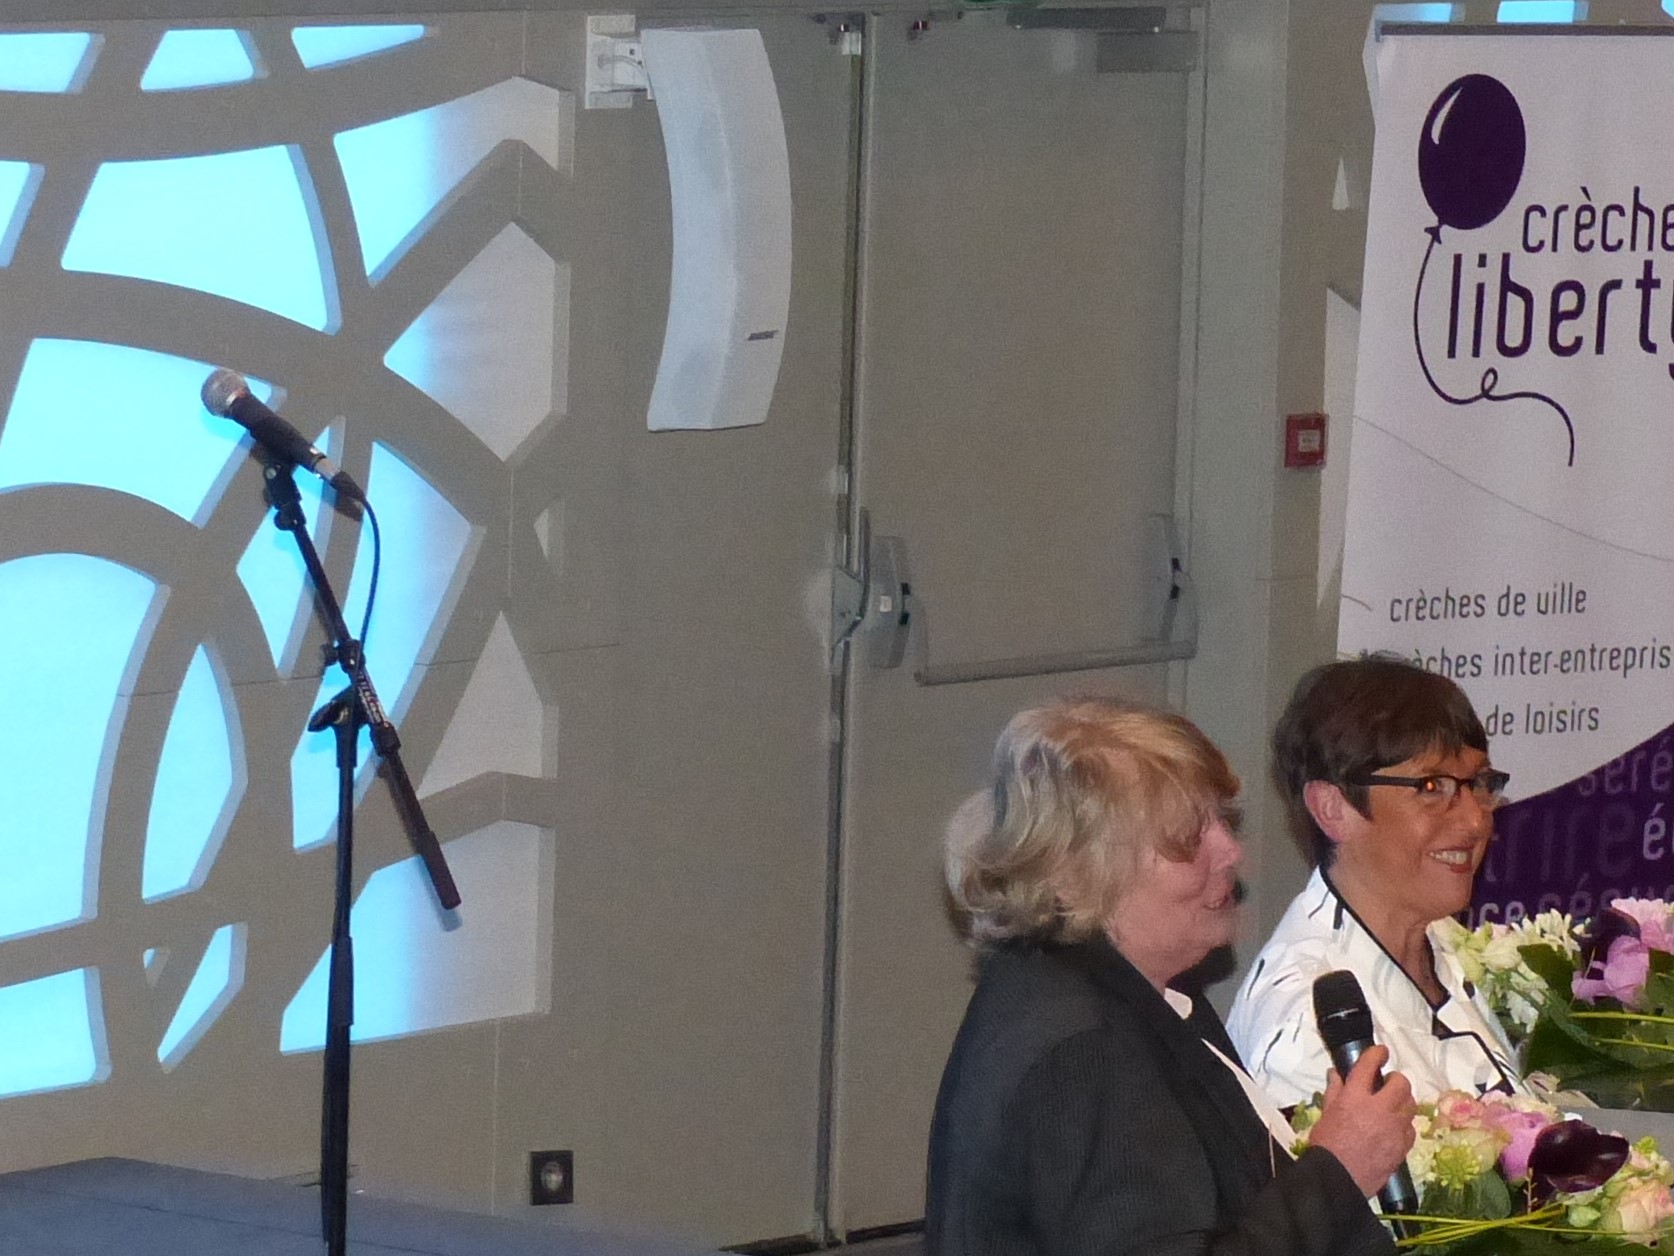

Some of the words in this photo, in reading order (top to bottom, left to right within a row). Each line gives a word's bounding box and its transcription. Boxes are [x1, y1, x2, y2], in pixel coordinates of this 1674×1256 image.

[1389, 586, 1486, 623] crèches
[1496, 584, 1527, 617] de
[1402, 645, 1483, 680] èches
[1485, 704, 1515, 737] de
[1524, 700, 1600, 735] loisirs
